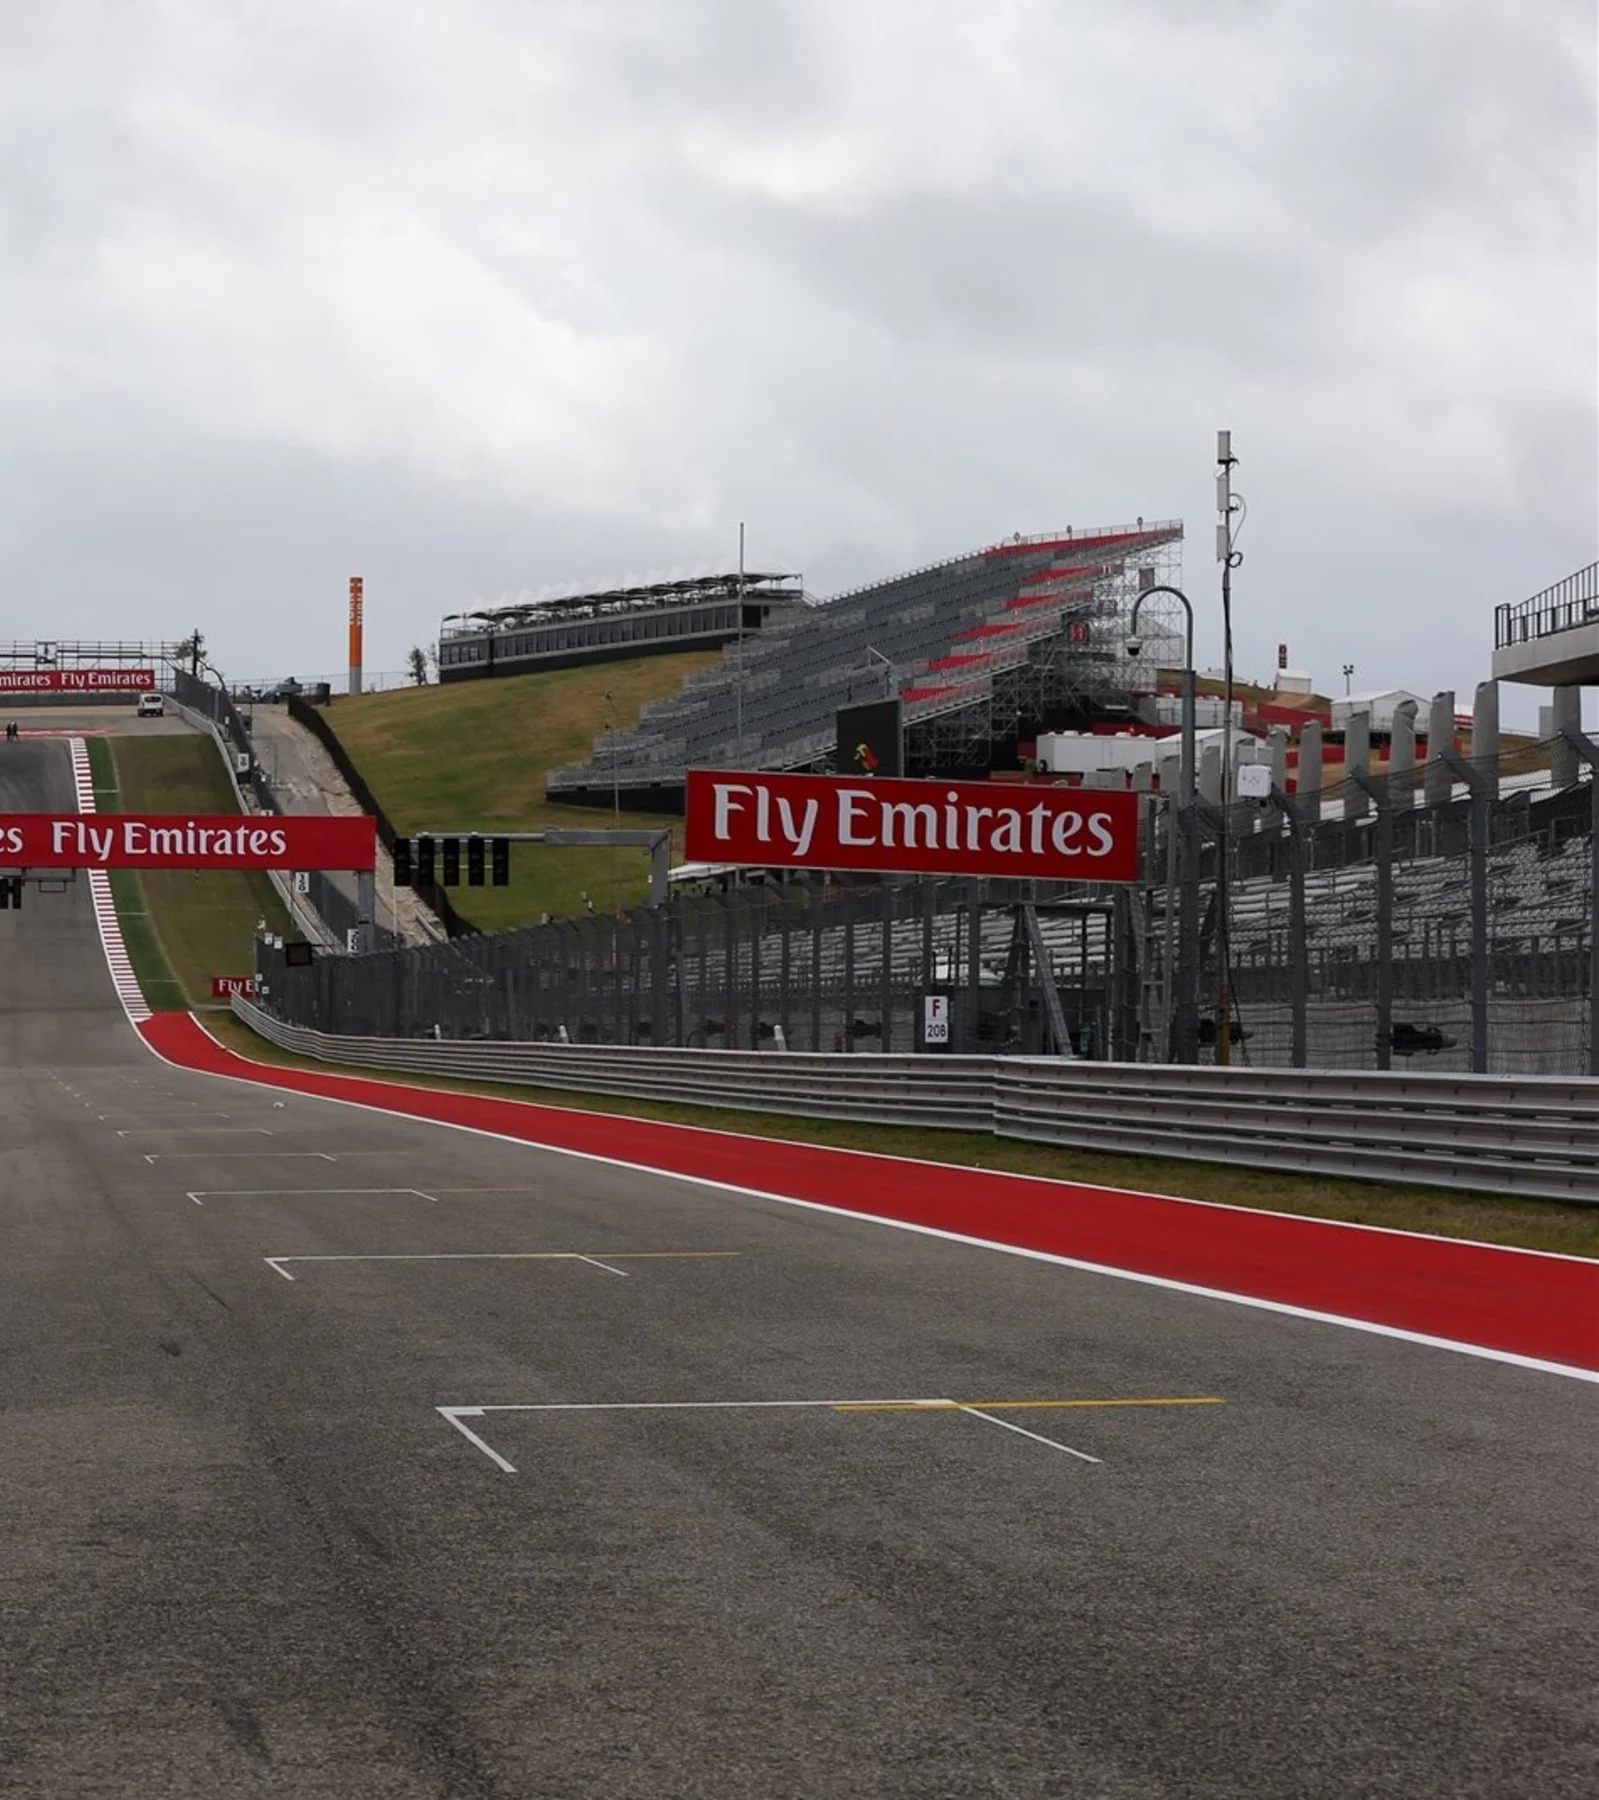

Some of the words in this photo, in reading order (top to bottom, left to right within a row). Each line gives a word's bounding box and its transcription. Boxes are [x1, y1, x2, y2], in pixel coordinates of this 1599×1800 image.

[61, 673, 85, 691] Fly
[88, 671, 150, 686] Emirates
[711, 784, 818, 857] Fly
[837, 790, 1114, 856] Emirates
[51, 821, 112, 860] Fly
[122, 821, 287, 857] Emirates
[932, 998, 941, 1018] F
